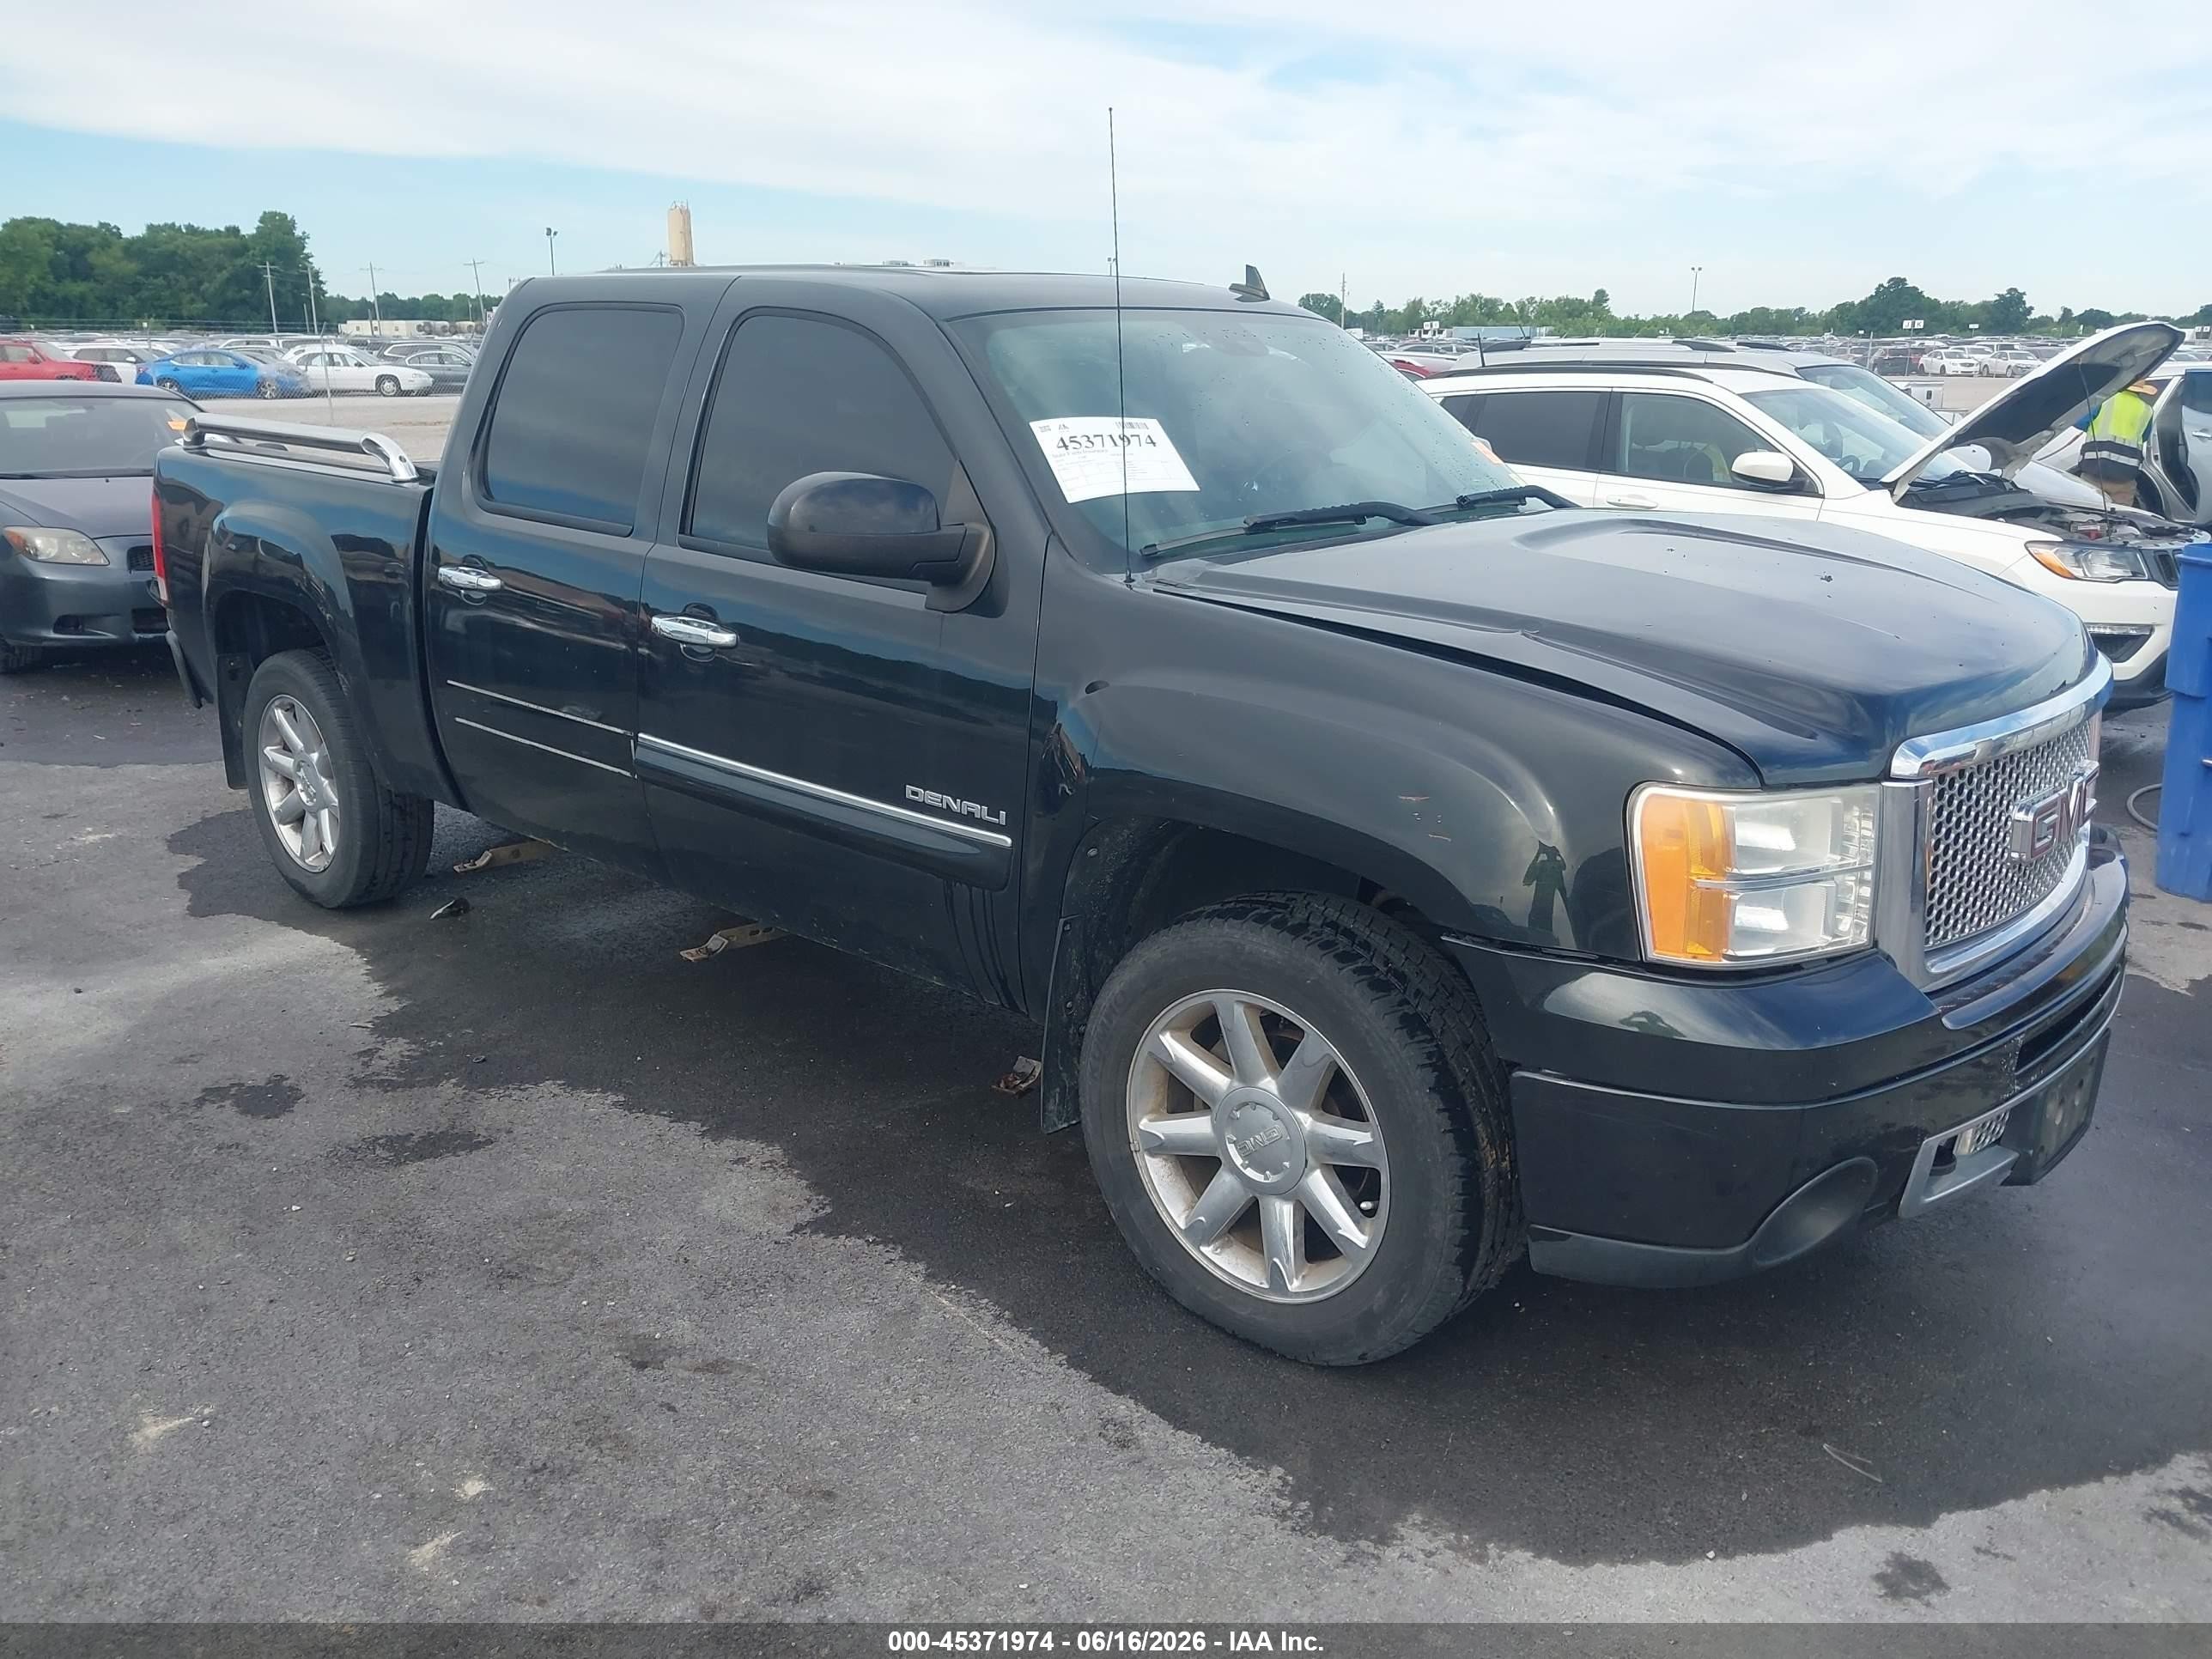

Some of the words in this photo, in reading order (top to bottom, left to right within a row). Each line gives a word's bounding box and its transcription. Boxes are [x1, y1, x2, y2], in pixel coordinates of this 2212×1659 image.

[1056, 433, 1157, 452] 45371974
[905, 784, 1007, 825] DENALI
[2012, 759, 2100, 860] GMC
[1236, 1123, 1284, 1158] GMC
